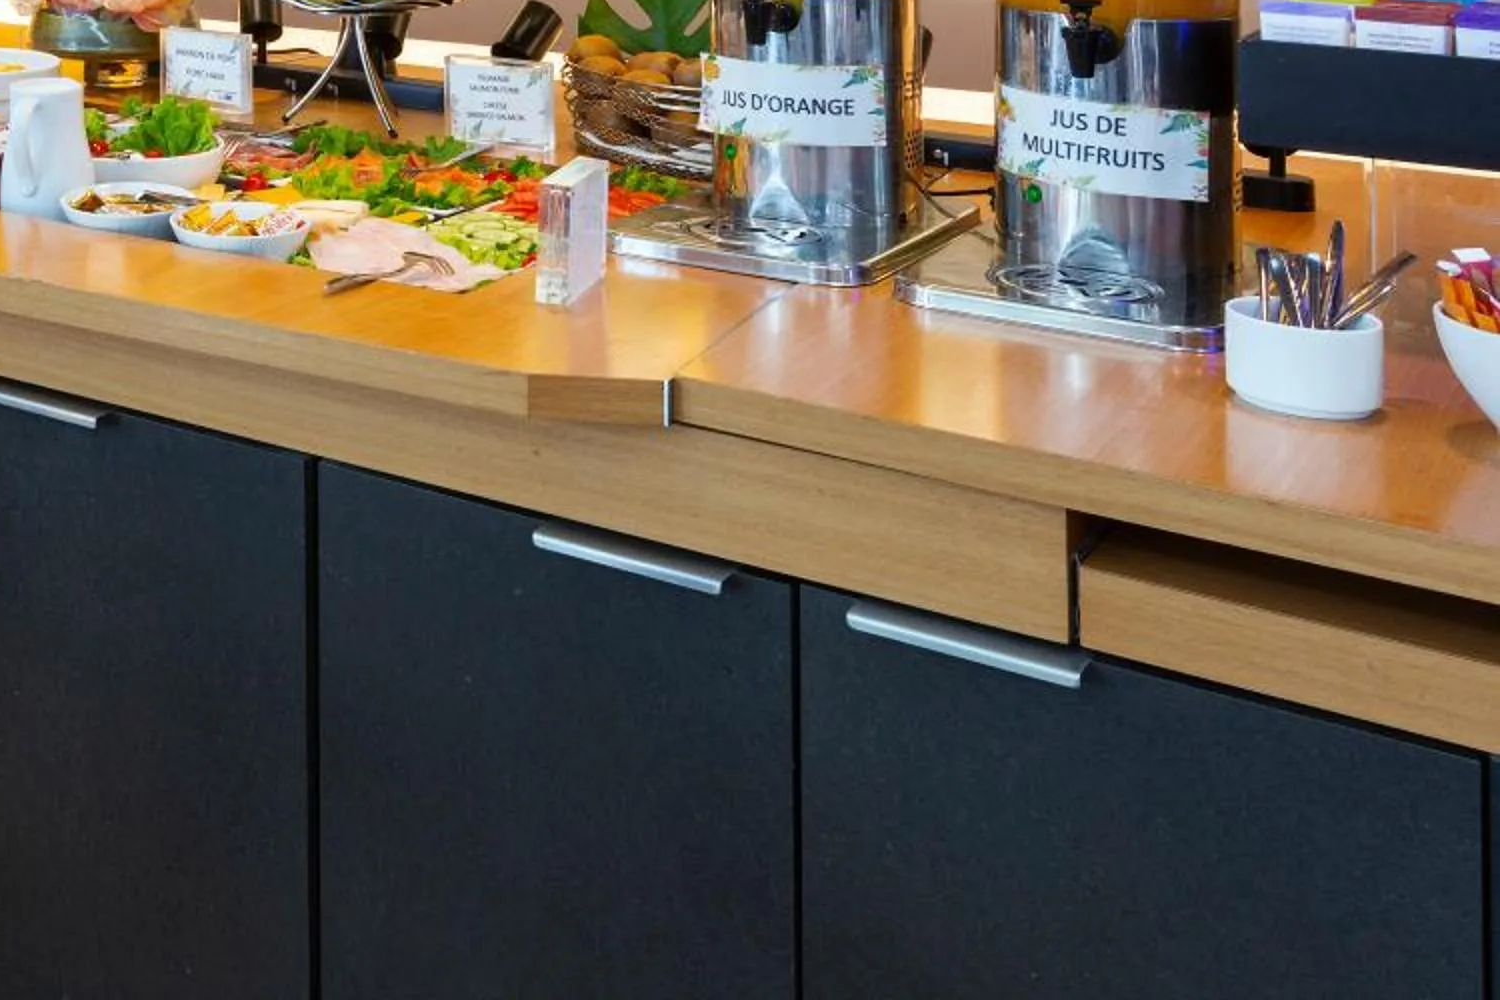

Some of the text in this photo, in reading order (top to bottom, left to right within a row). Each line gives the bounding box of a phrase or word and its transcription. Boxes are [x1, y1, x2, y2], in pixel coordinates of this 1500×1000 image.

[722, 88, 856, 117] JUS D'ORANGE
[1049, 108, 1128, 137] JUS DE
[1022, 132, 1166, 172] MULTIFRUITS
